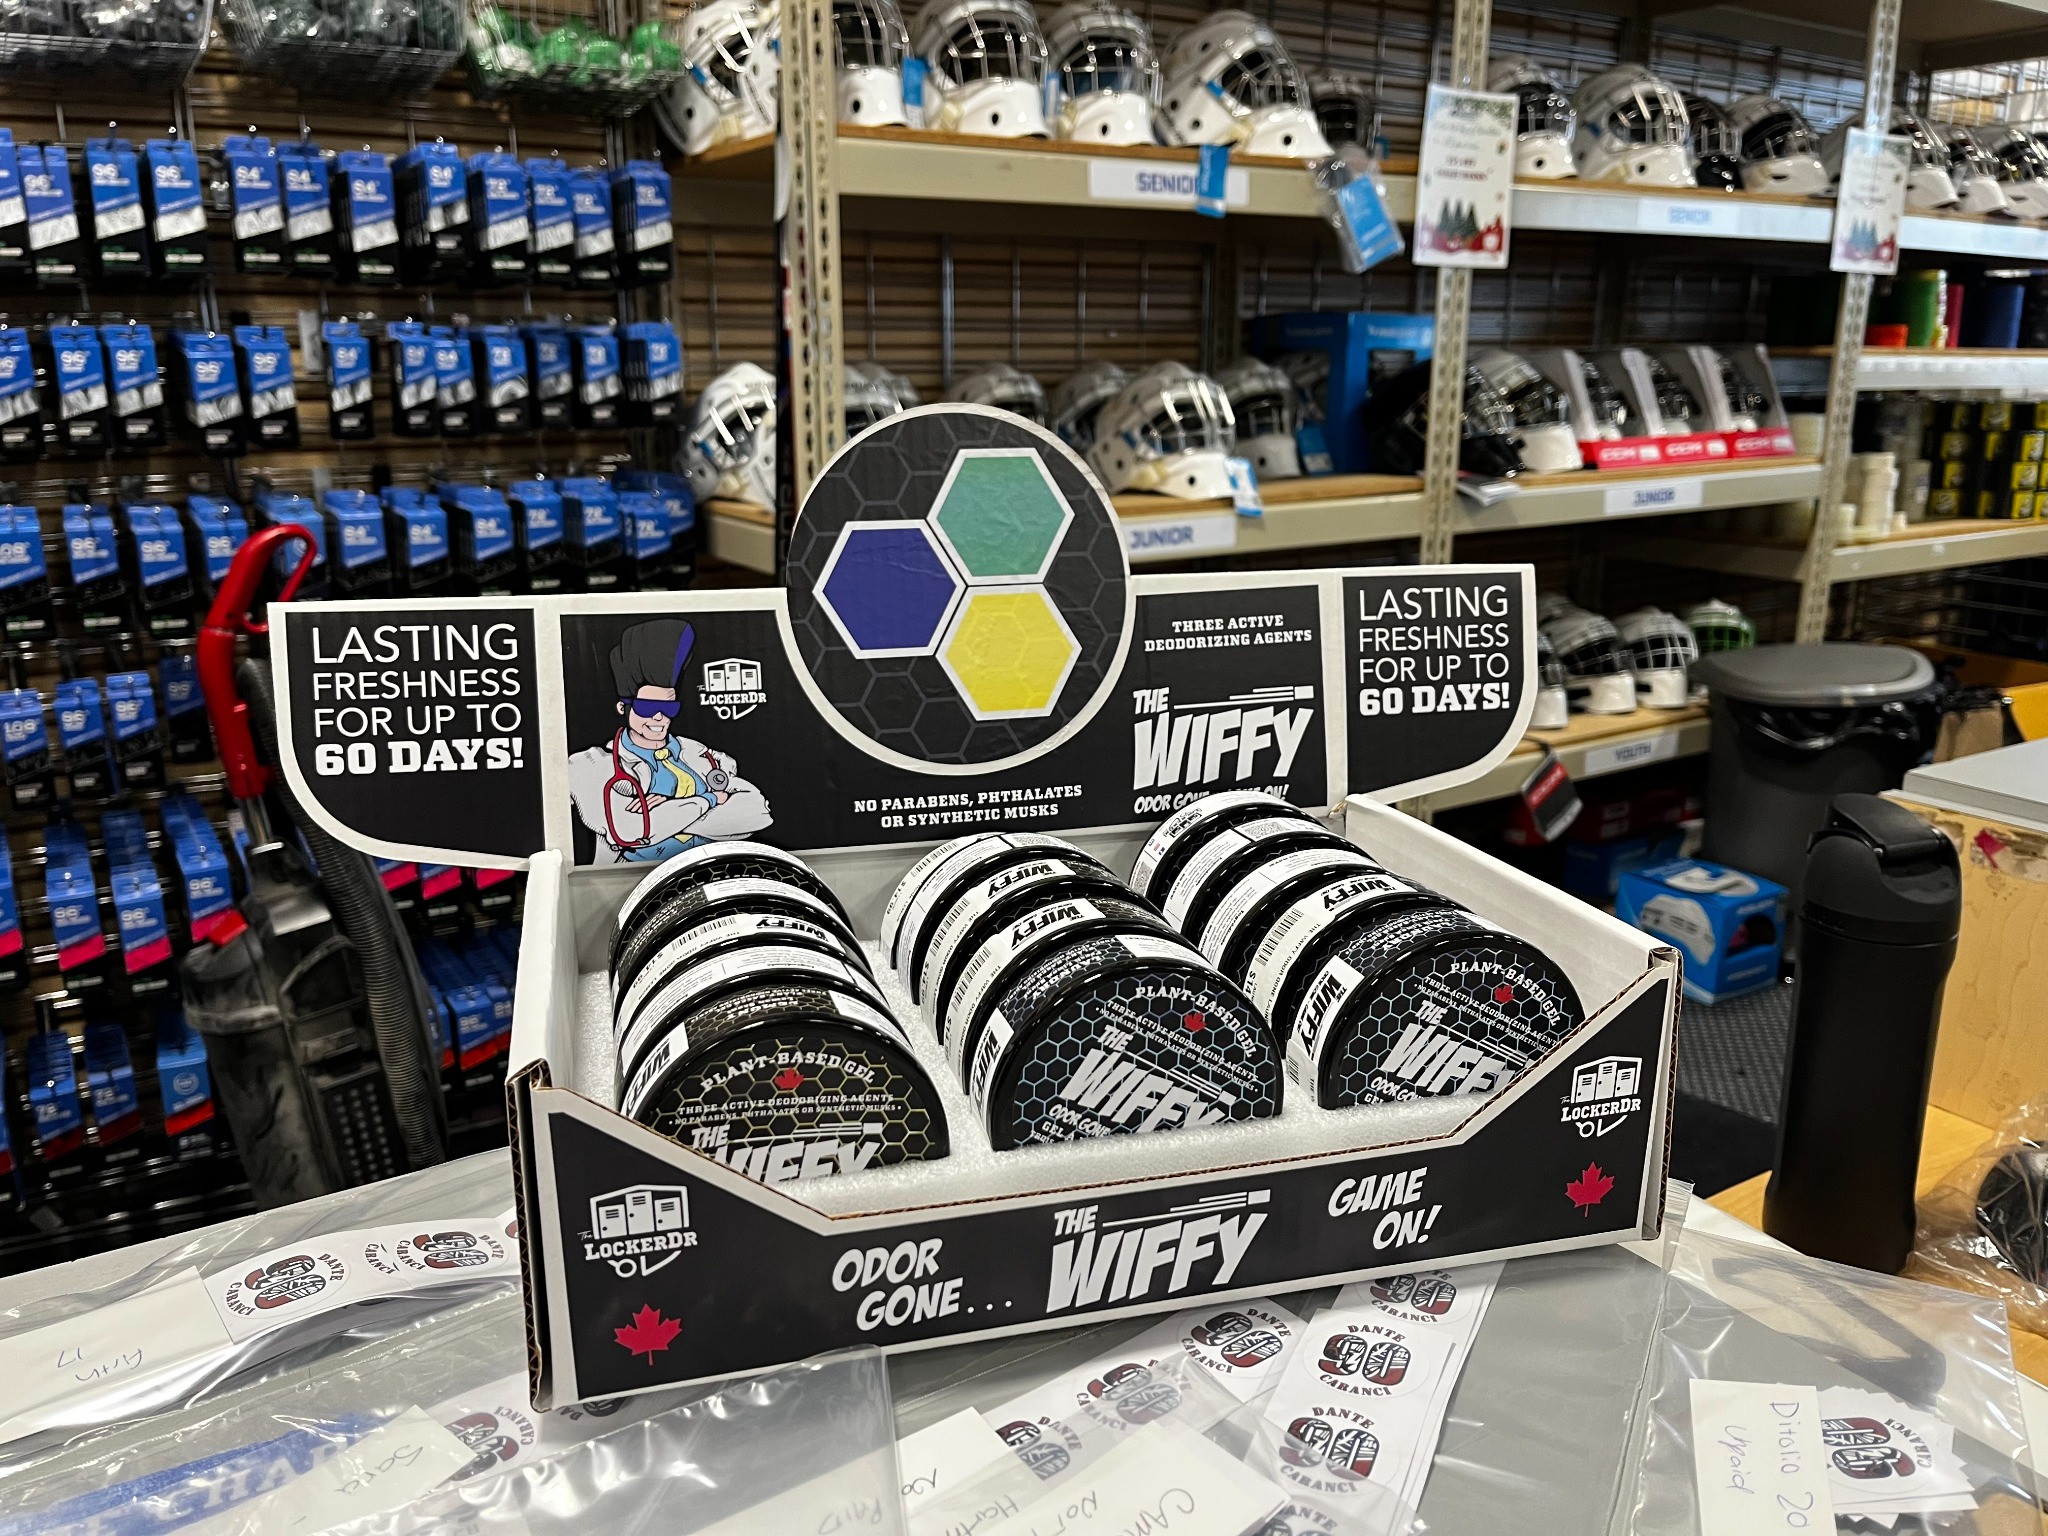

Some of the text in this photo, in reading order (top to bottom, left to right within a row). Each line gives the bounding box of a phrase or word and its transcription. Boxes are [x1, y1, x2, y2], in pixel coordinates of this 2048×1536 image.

[1137, 172, 1200, 194] SENIO
[1359, 585, 1508, 621] LASTING
[1172, 615, 1284, 632] THREE ACTIVE
[1359, 623, 1509, 652] FRESHNESS
[312, 623, 518, 664] LASTING
[1144, 629, 1312, 652] DEODORIZING AGENTS
[1360, 653, 1509, 683] FOR UP TO
[313, 668, 521, 700] FRESHNESS
[1359, 682, 1510, 716] 60 DAYS!
[1132, 687, 1170, 714] THE
[315, 702, 522, 737] FOR UP TO
[315, 737, 524, 776] 60 DAYS!
[1133, 705, 1314, 791] WIFFY
[854, 784, 1082, 812] NO PARABENS, PHTHALATES
[1134, 794, 1172, 814] ODOR
[881, 803, 1059, 828] OR SYNTHETIC MUSKS
[987, 863, 1052, 899] WIFFY
[1323, 879, 1388, 910] WIFFY
[756, 917, 829, 943] WIFFY
[1011, 903, 1081, 950] WIFFY
[1450, 962, 1561, 1026] PLANT-BASED GEL
[1135, 986, 1241, 1031] PLANT-BASED
[1237, 1029, 1257, 1058] GEL
[1301, 974, 1341, 1055] WIFFY
[1415, 1000, 1448, 1025] THE
[1425, 976, 1557, 1046] THREE ACTIVE DEODORIZING AGENT
[1097, 1024, 1133, 1052] THE
[1107, 1000, 1259, 1081] THREE ACTIVE DEODORIZING AGENTS
[700, 1051, 875, 1091] PLANT-BASED GEL
[1370, 1076, 1398, 1098] ODOR
[678, 1094, 894, 1115] THREE ACTIVE DEODORIZING AGENTS
[802, 1106, 814, 1114] OR
[1049, 1104, 1083, 1126] ODOR
[1560, 1098, 1641, 1122] LOCKERDR
[691, 1123, 731, 1150] THE
[1042, 1121, 1065, 1137] GEL
[1326, 1166, 1428, 1218] GAME
[577, 1231, 593, 1240] The
[1054, 1205, 1099, 1236] THE
[1371, 1205, 1443, 1251] ON!
[365, 1243, 395, 1275] CARANCI
[396, 1239, 427, 1270] CARANCI
[478, 1234, 505, 1259] DANTE
[584, 1232, 698, 1260] LOCKERDR
[317, 1253, 344, 1281] DANTE
[831, 1238, 943, 1293] ODOR
[1046, 1212, 1268, 1314] WIFFY
[226, 1281, 256, 1316] CARANCI
[1370, 1299, 1438, 1323] CARANCI
[1247, 1308, 1292, 1338] DANTE
[1347, 1325, 1406, 1342] DANTE
[1181, 1337, 1233, 1374] CARANCI
[1320, 1374, 1392, 1397] CARANCI
[496, 1405, 535, 1446] CARANCI
[1076, 1392, 1128, 1431] CARANCI
[1311, 1406, 1375, 1429] DANTE
[1037, 1416, 1083, 1450] DANTE
[1884, 1418, 1933, 1468] CARANCI
[1279, 1465, 1358, 1493] CARANCI
[1287, 1503, 1338, 1532] ANTE
